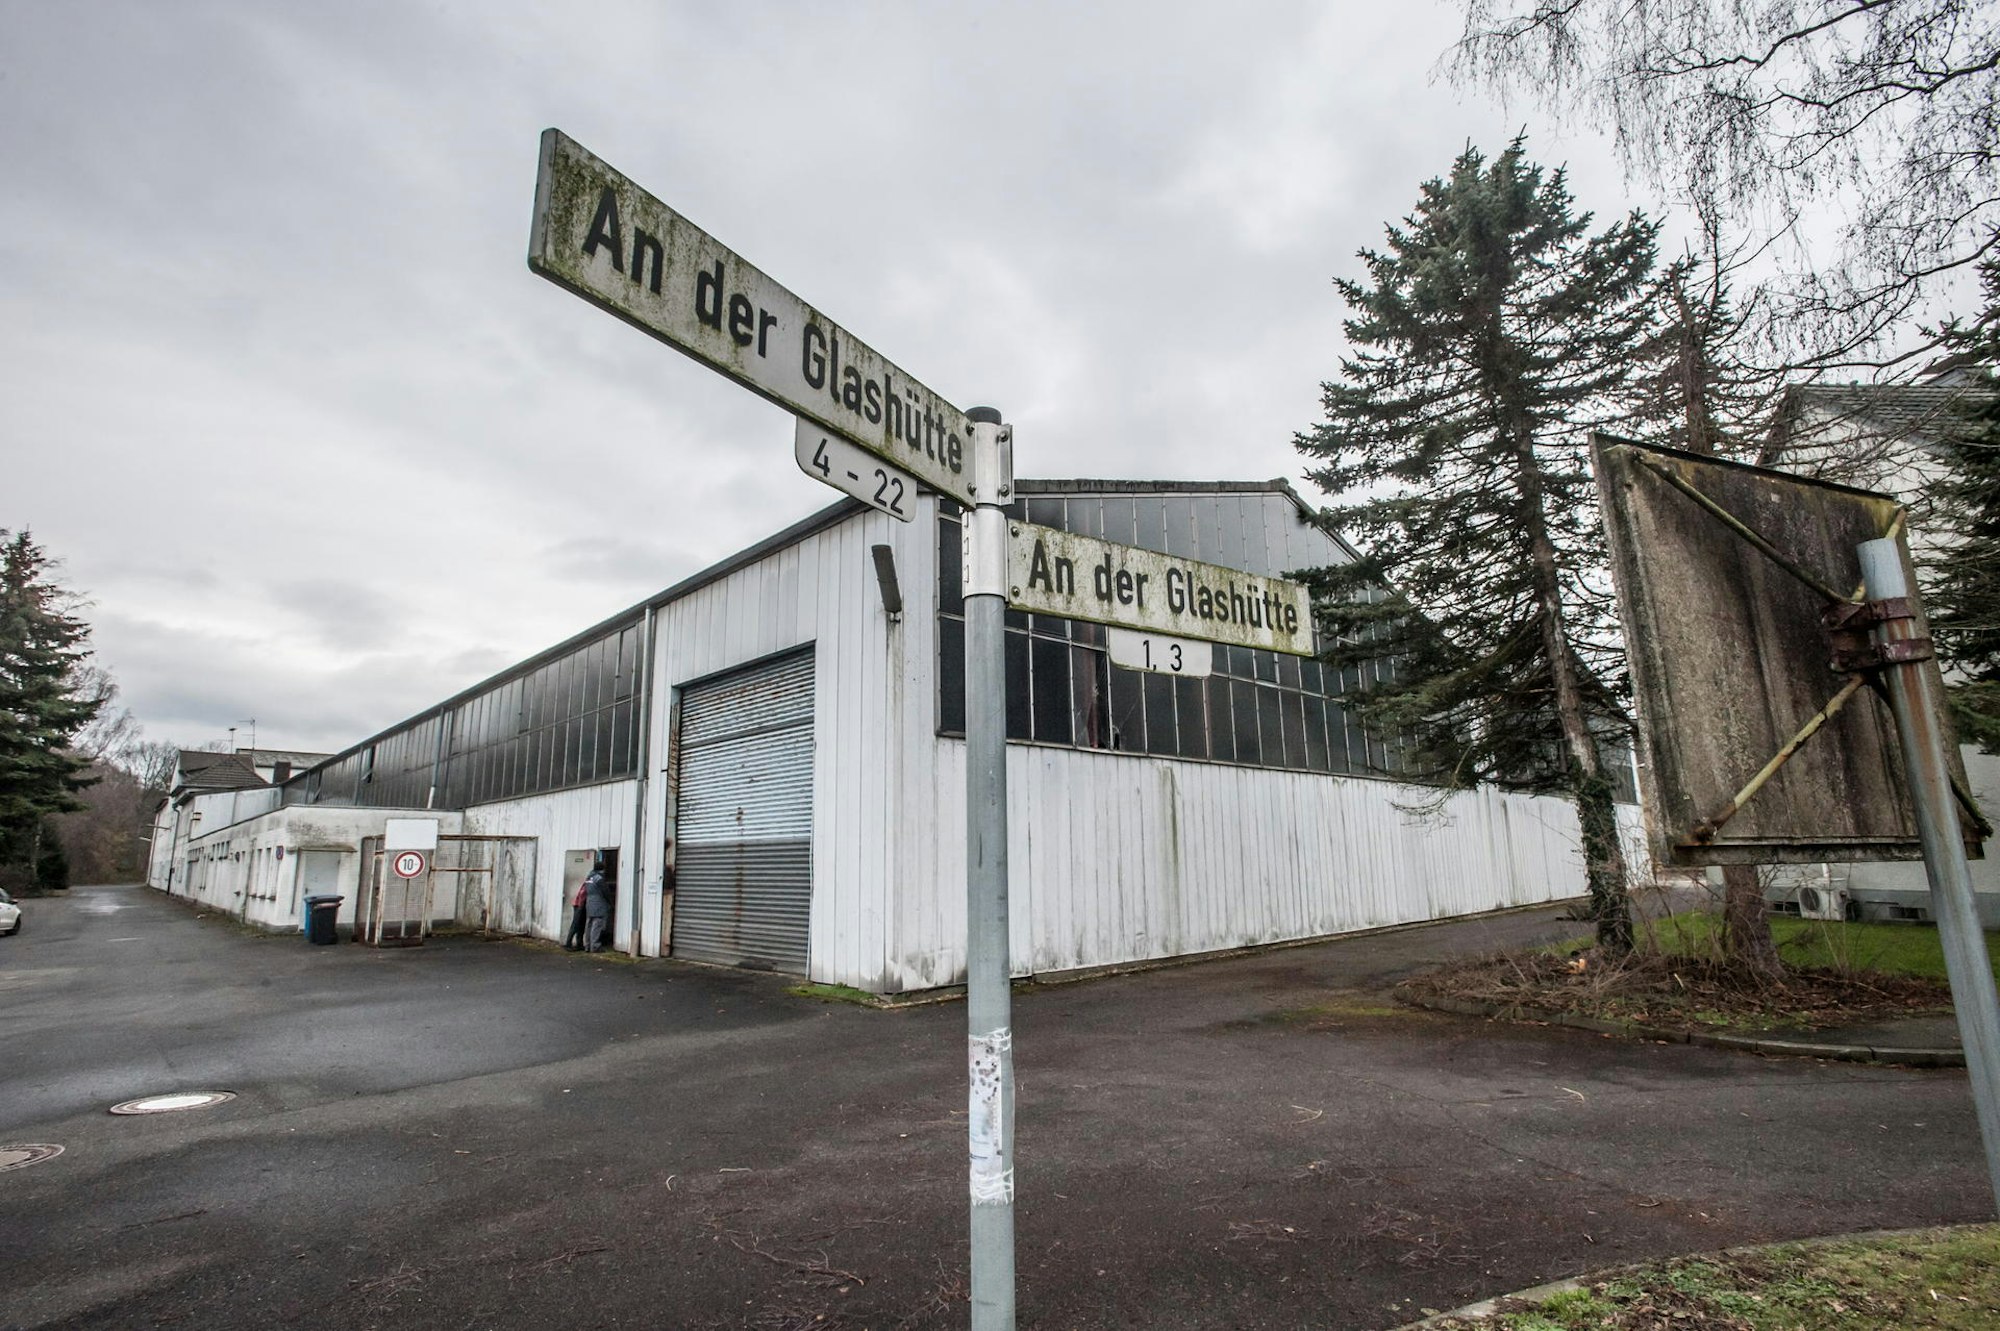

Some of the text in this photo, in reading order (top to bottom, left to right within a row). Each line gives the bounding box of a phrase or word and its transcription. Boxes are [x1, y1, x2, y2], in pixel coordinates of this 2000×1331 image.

[582, 187, 963, 475] An der Glashütte
[812, 438, 831, 478] 4
[873, 468, 904, 516] 22
[1028, 539, 1298, 635] An der Glashütte
[1169, 643, 1183, 672] 3
[402, 858, 414, 871] 10
